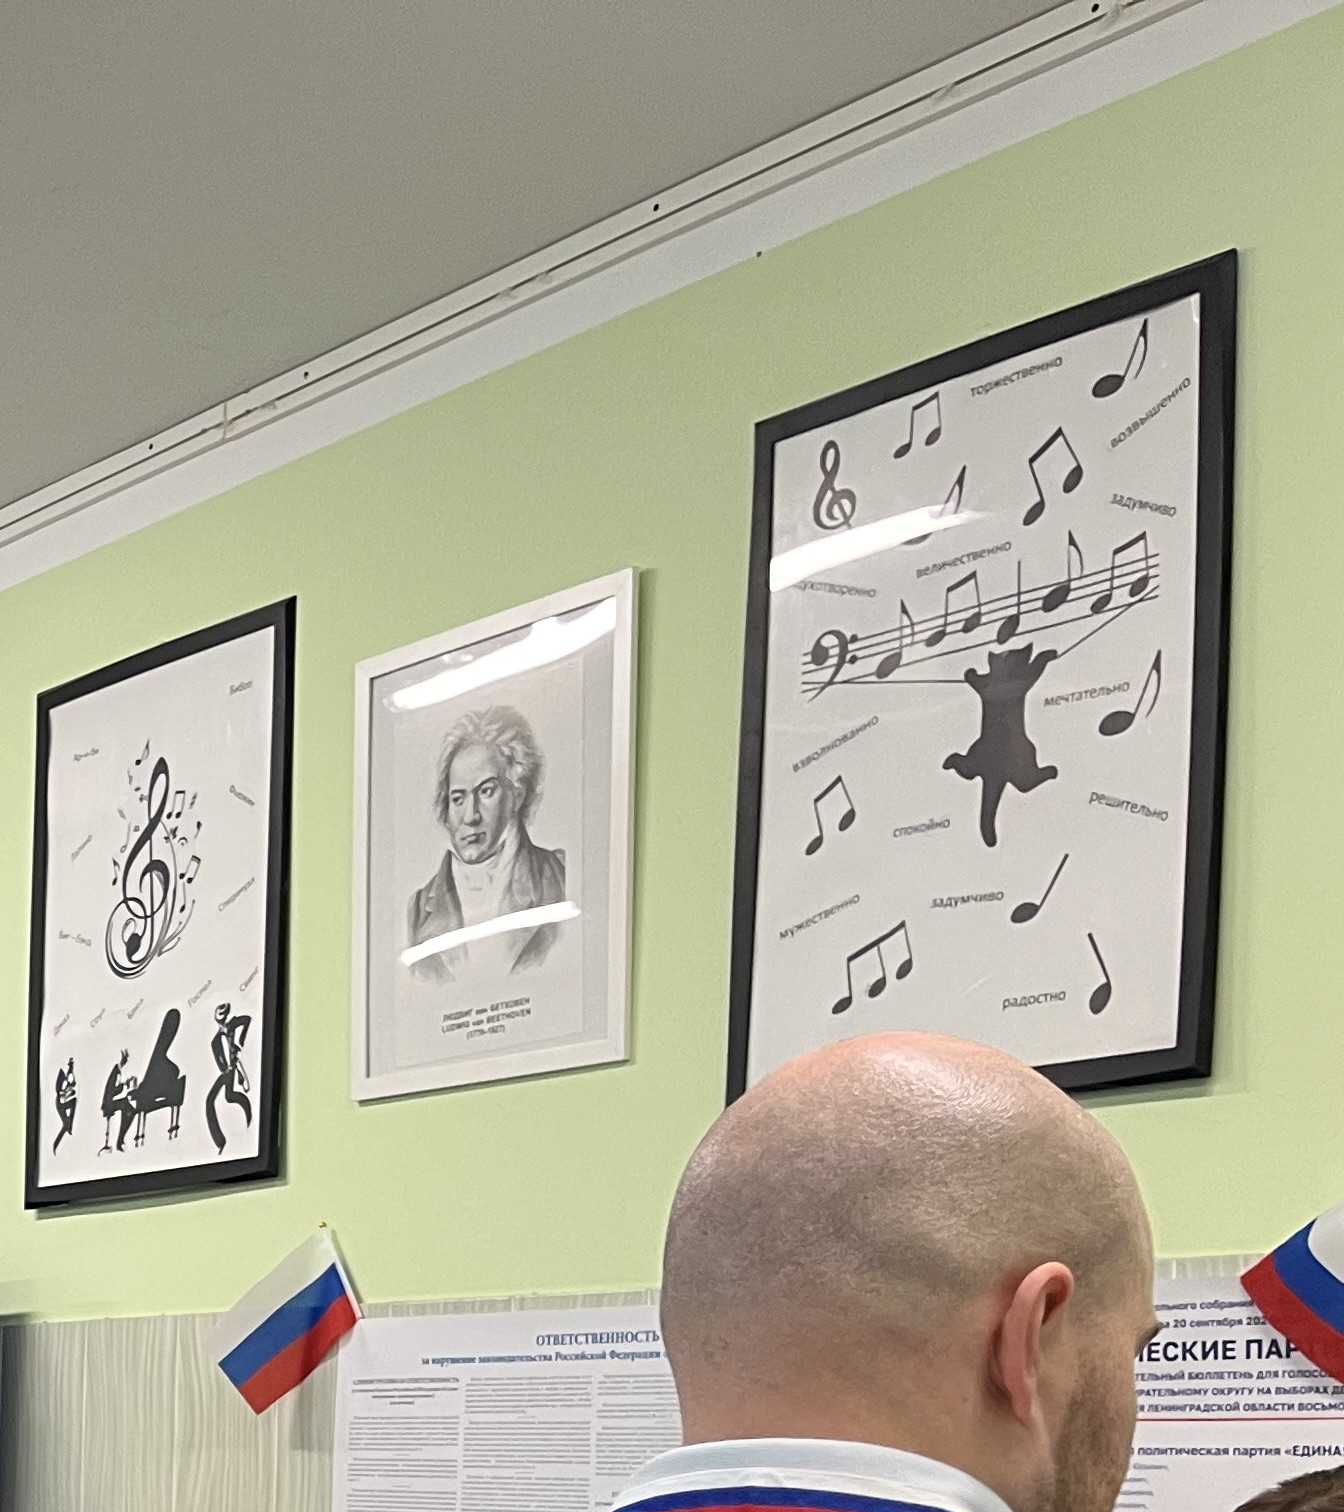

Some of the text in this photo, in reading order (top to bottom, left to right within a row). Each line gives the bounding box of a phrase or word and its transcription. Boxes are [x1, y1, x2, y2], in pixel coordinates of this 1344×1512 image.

[970, 356, 1062, 397] торжественно
[1111, 378, 1191, 448] возвышенно
[916, 542, 1012, 579] величественно
[1044, 682, 1130, 707] мечтательно
[1089, 792, 1168, 821] решительно
[893, 816, 950, 838] спокойно
[930, 891, 1004, 909] задумчиво
[779, 894, 860, 939] мужественно
[1002, 991, 1067, 1011] радостно
[1173, 1319, 1186, 1328] 20
[1190, 1317, 1243, 1328] сентября
[536, 1330, 660, 1346] ОТВЕТСТВЕННОСТЬ
[1139, 1339, 1300, 1362] ЕСКИЕ ПАР
[1136, 1370, 1184, 1381] ТЕЛЬНЫЙ
[1188, 1371, 1254, 1380] БЮЛЛЕТЕНЬ
[1256, 1370, 1279, 1379] ДЛЯ
[1136, 1388, 1208, 1397] РАТЕЛЬНОМУ
[1212, 1387, 1254, 1396] ОКРУГУ
[1257, 1387, 1272, 1395] НА
[1275, 1386, 1329, 1395] ВЫБОРАХ
[1147, 1402, 1240, 1413] ЛЕНИНГРАДСКОЙ
[1243, 1402, 1294, 1412] ОБЛАСТИ
[1298, 1402, 1344, 1412] ВОСЬМО
[1138, 1446, 1230, 1456] политическая
[1232, 1447, 1281, 1458] партия
[1284, 1444, 1344, 1458] «ЕДИНА
